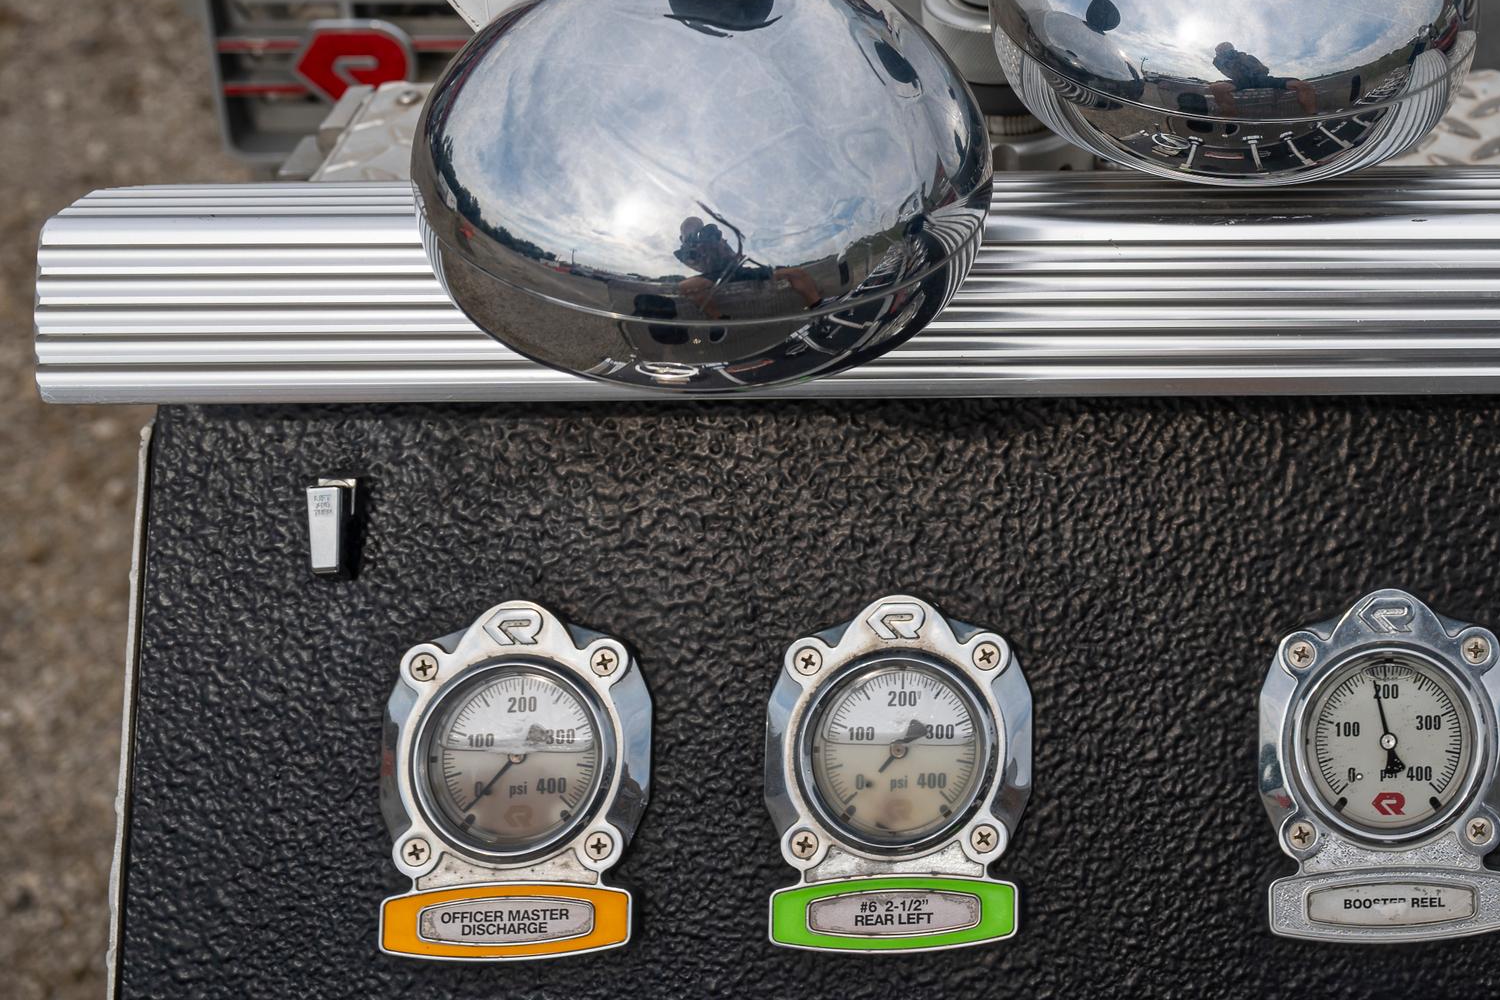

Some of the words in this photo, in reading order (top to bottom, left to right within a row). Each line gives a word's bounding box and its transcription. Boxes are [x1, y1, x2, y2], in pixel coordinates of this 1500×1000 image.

[888, 691, 917, 706] 200
[1374, 684, 1399, 700] 200
[507, 696, 537, 713] 200
[1335, 722, 1360, 737] 100
[1416, 715, 1441, 731] 300
[849, 727, 874, 742] 100
[926, 724, 954, 740] 300
[468, 733, 494, 748] 100
[917, 773, 946, 789] 400
[1406, 766, 1432, 781] 400
[509, 781, 528, 798] psi
[536, 777, 567, 795] 400
[890, 774, 908, 792] psi
[860, 901, 877, 913] #6
[1411, 897, 1446, 908] REEL
[440, 911, 504, 925] OFFICER
[508, 908, 569, 922] MASTER
[854, 914, 894, 926] REAR
[898, 912, 934, 925] LEFT
[461, 922, 548, 936] DISCHARGE
